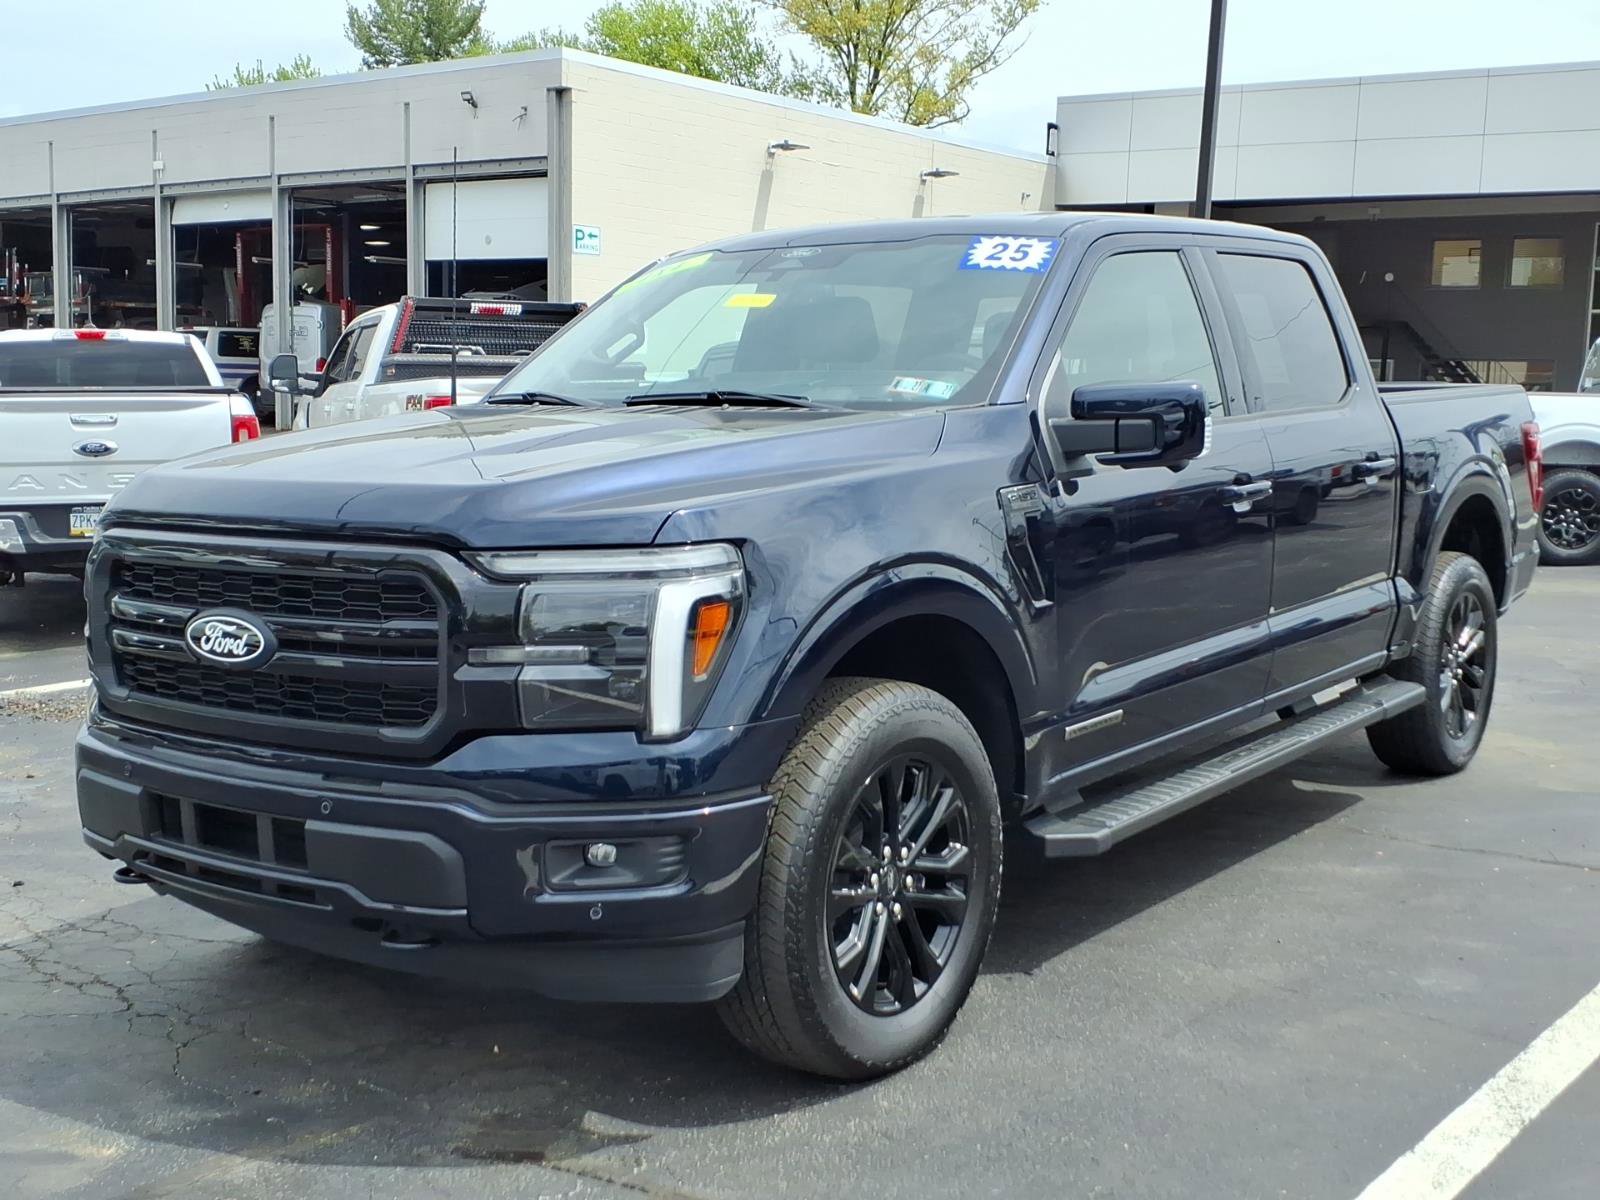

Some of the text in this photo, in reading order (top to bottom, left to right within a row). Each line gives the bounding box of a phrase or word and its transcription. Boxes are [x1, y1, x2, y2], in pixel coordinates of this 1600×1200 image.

[984, 242, 1034, 262] 25
[405, 394, 423, 410] FX4
[71, 514, 93, 528] ZPK
[200, 621, 248, 656] Ford
